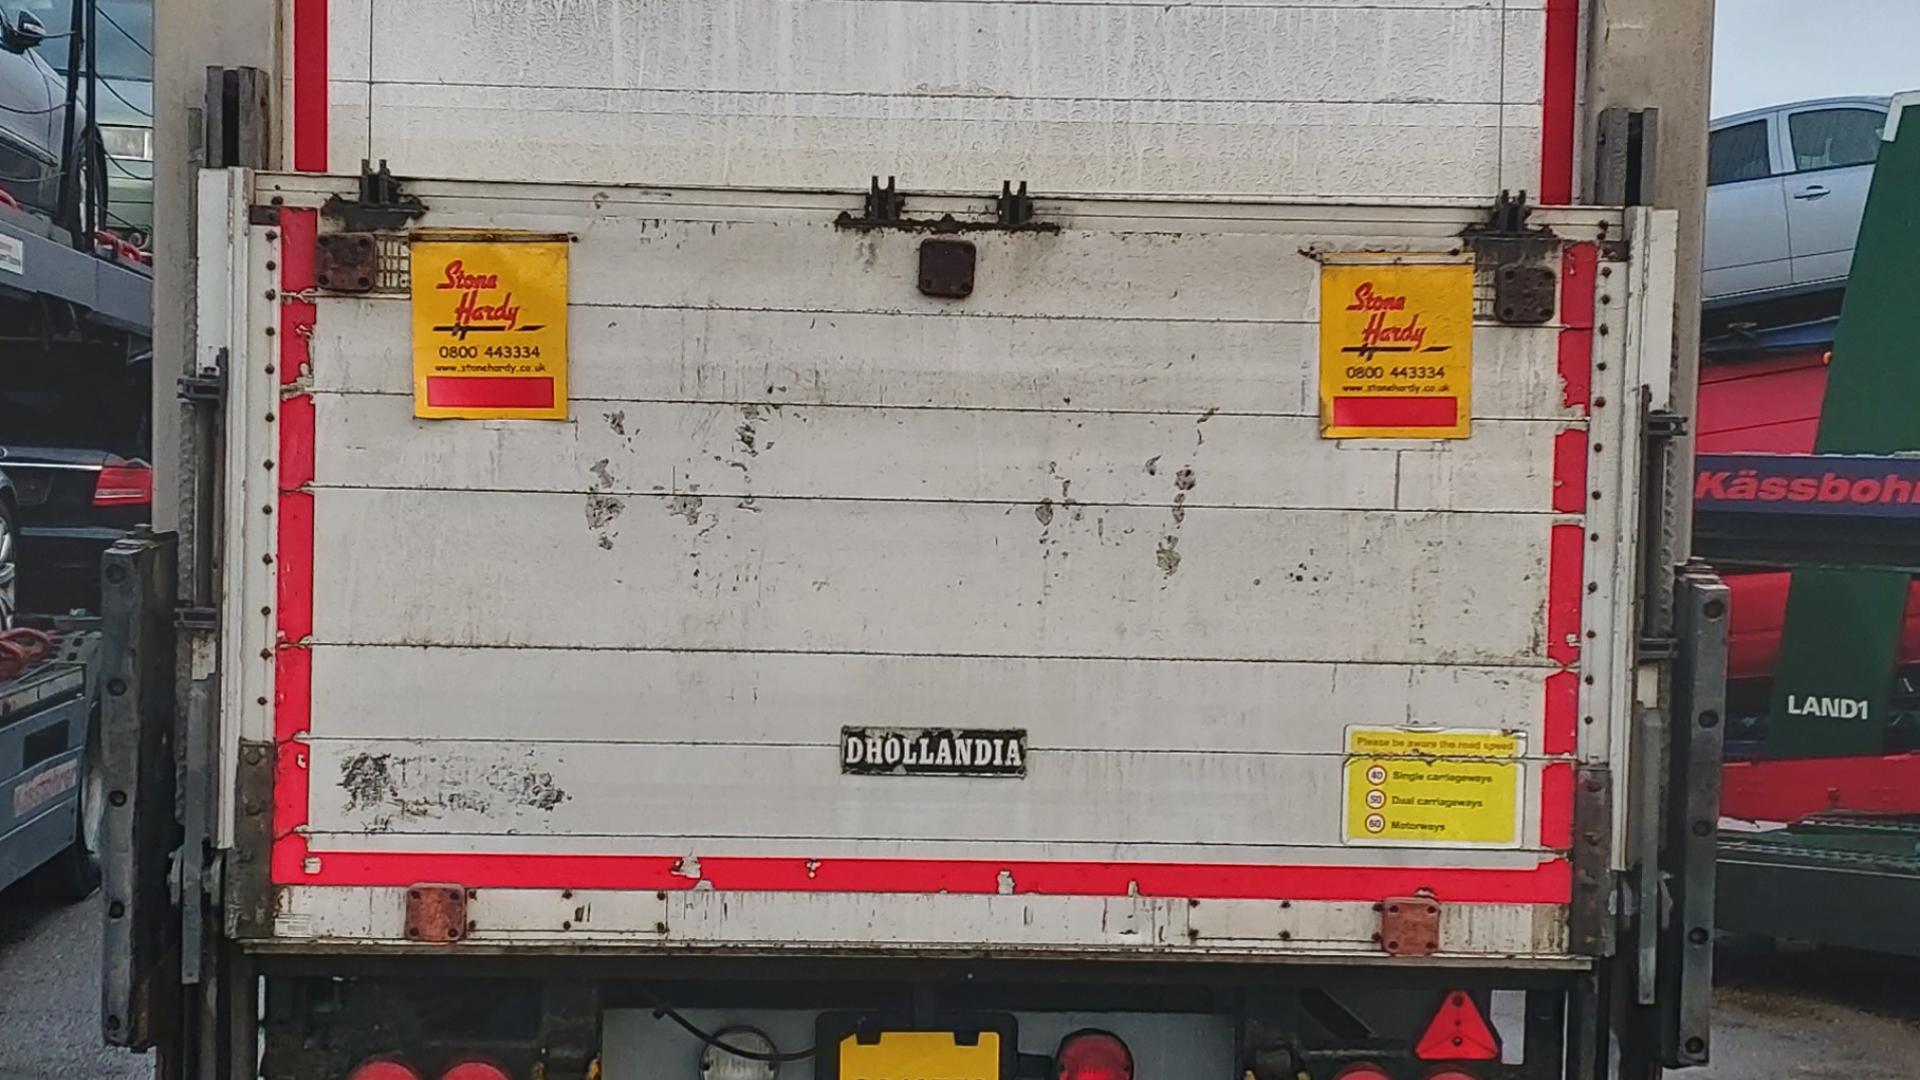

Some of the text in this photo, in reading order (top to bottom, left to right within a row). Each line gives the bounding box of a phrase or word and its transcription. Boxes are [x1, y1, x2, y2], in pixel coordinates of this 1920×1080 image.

[436, 260, 498, 289] Stone
[1346, 281, 1406, 311] Stone
[455, 290, 520, 330] Hardy
[1363, 312, 1427, 351] Hardy
[438, 346, 540, 359] 0800 443334
[435, 363, 546, 374] www.stonehardy.co.uk
[1346, 366, 1445, 379] 0800 443334
[1342, 383, 1449, 394] www.stonehardy.co.uk
[1787, 695, 1869, 720] LAND1
[846, 737, 1022, 766] DHOLLANDIA
[1357, 736, 1390, 748] Please
[1391, 738, 1405, 748] be
[1407, 740, 1437, 749] aware
[1439, 739, 1457, 749] the
[1483, 740, 1515, 752] speed
[1392, 771, 1425, 782] Single
[1426, 773, 1493, 785] carriageways
[1391, 796, 1415, 805] Dual
[1417, 797, 1483, 809] carriageways
[1391, 821, 1446, 832] Motorways
